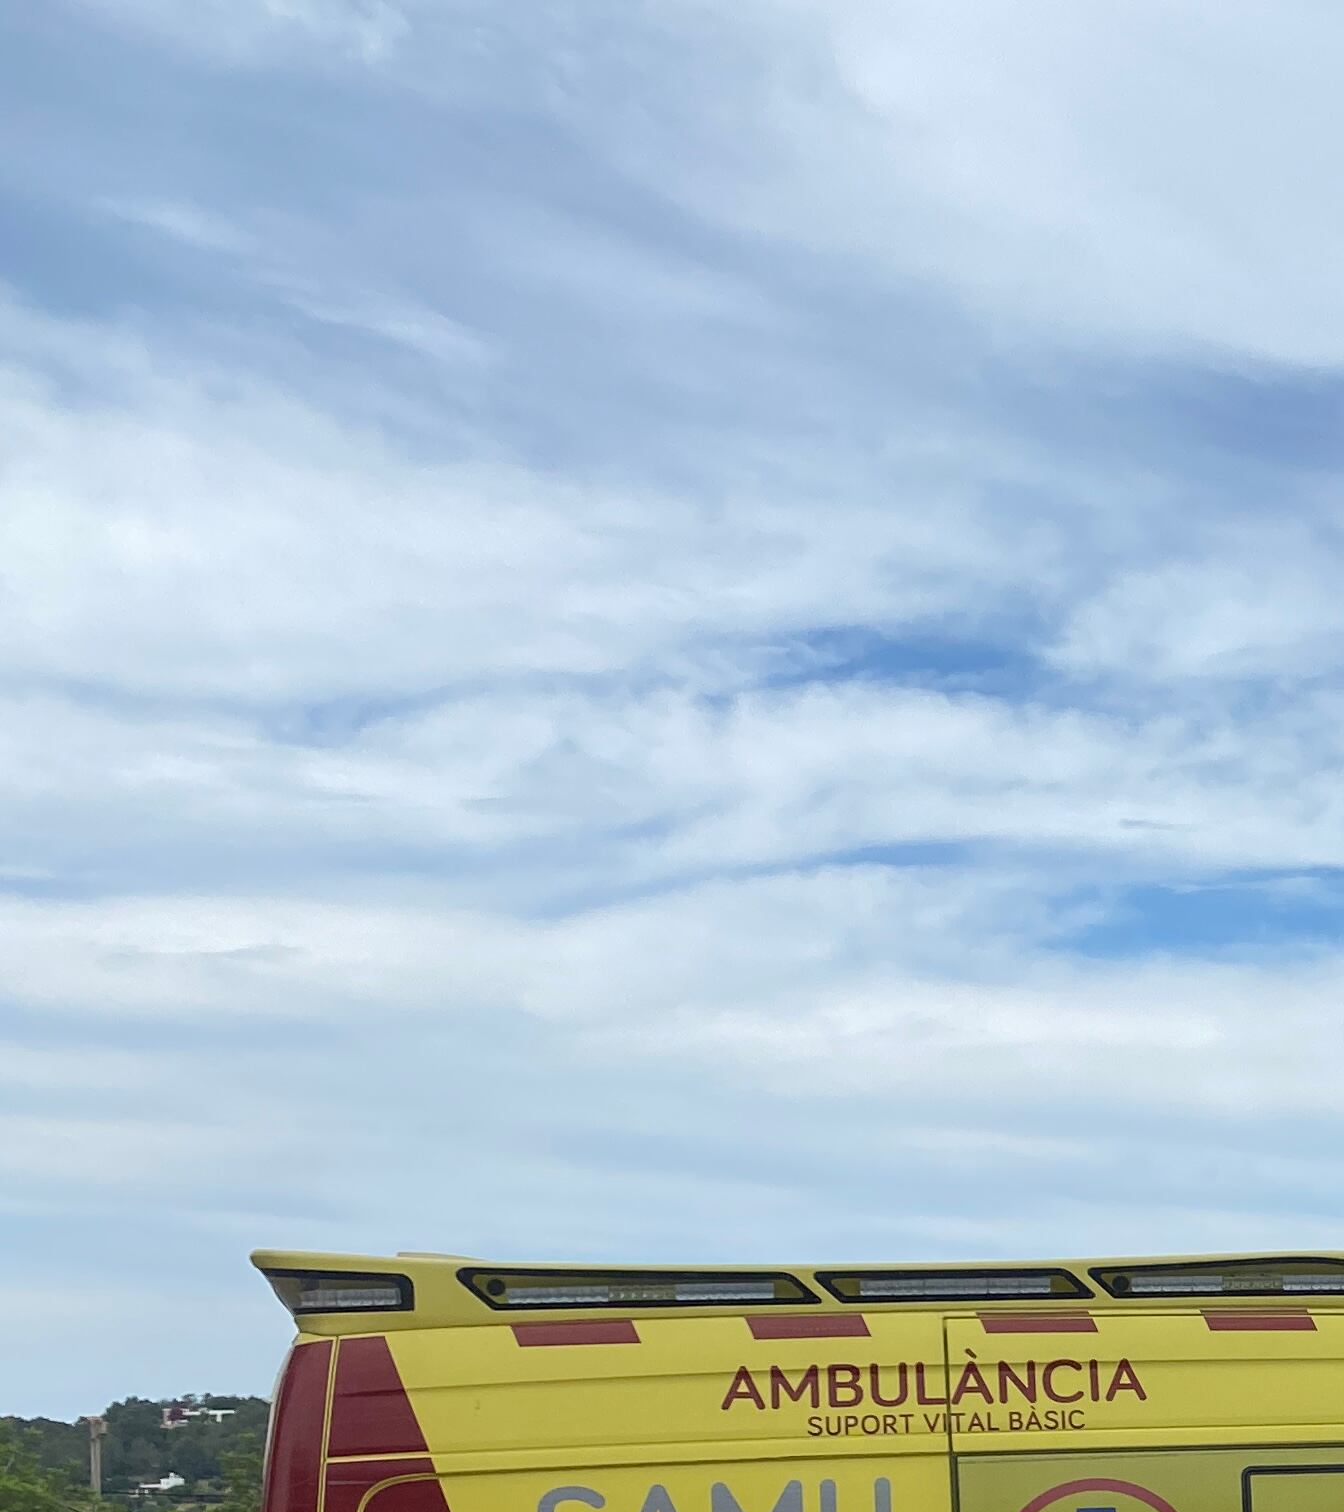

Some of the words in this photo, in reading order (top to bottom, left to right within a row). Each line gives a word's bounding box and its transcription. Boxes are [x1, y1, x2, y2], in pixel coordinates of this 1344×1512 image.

[721, 1348, 1147, 1410] AMBULÀNCIA
[807, 1413, 914, 1437] SUPORT
[923, 1411, 999, 1433] VITAL
[1008, 1406, 1086, 1431] BÀSIC
